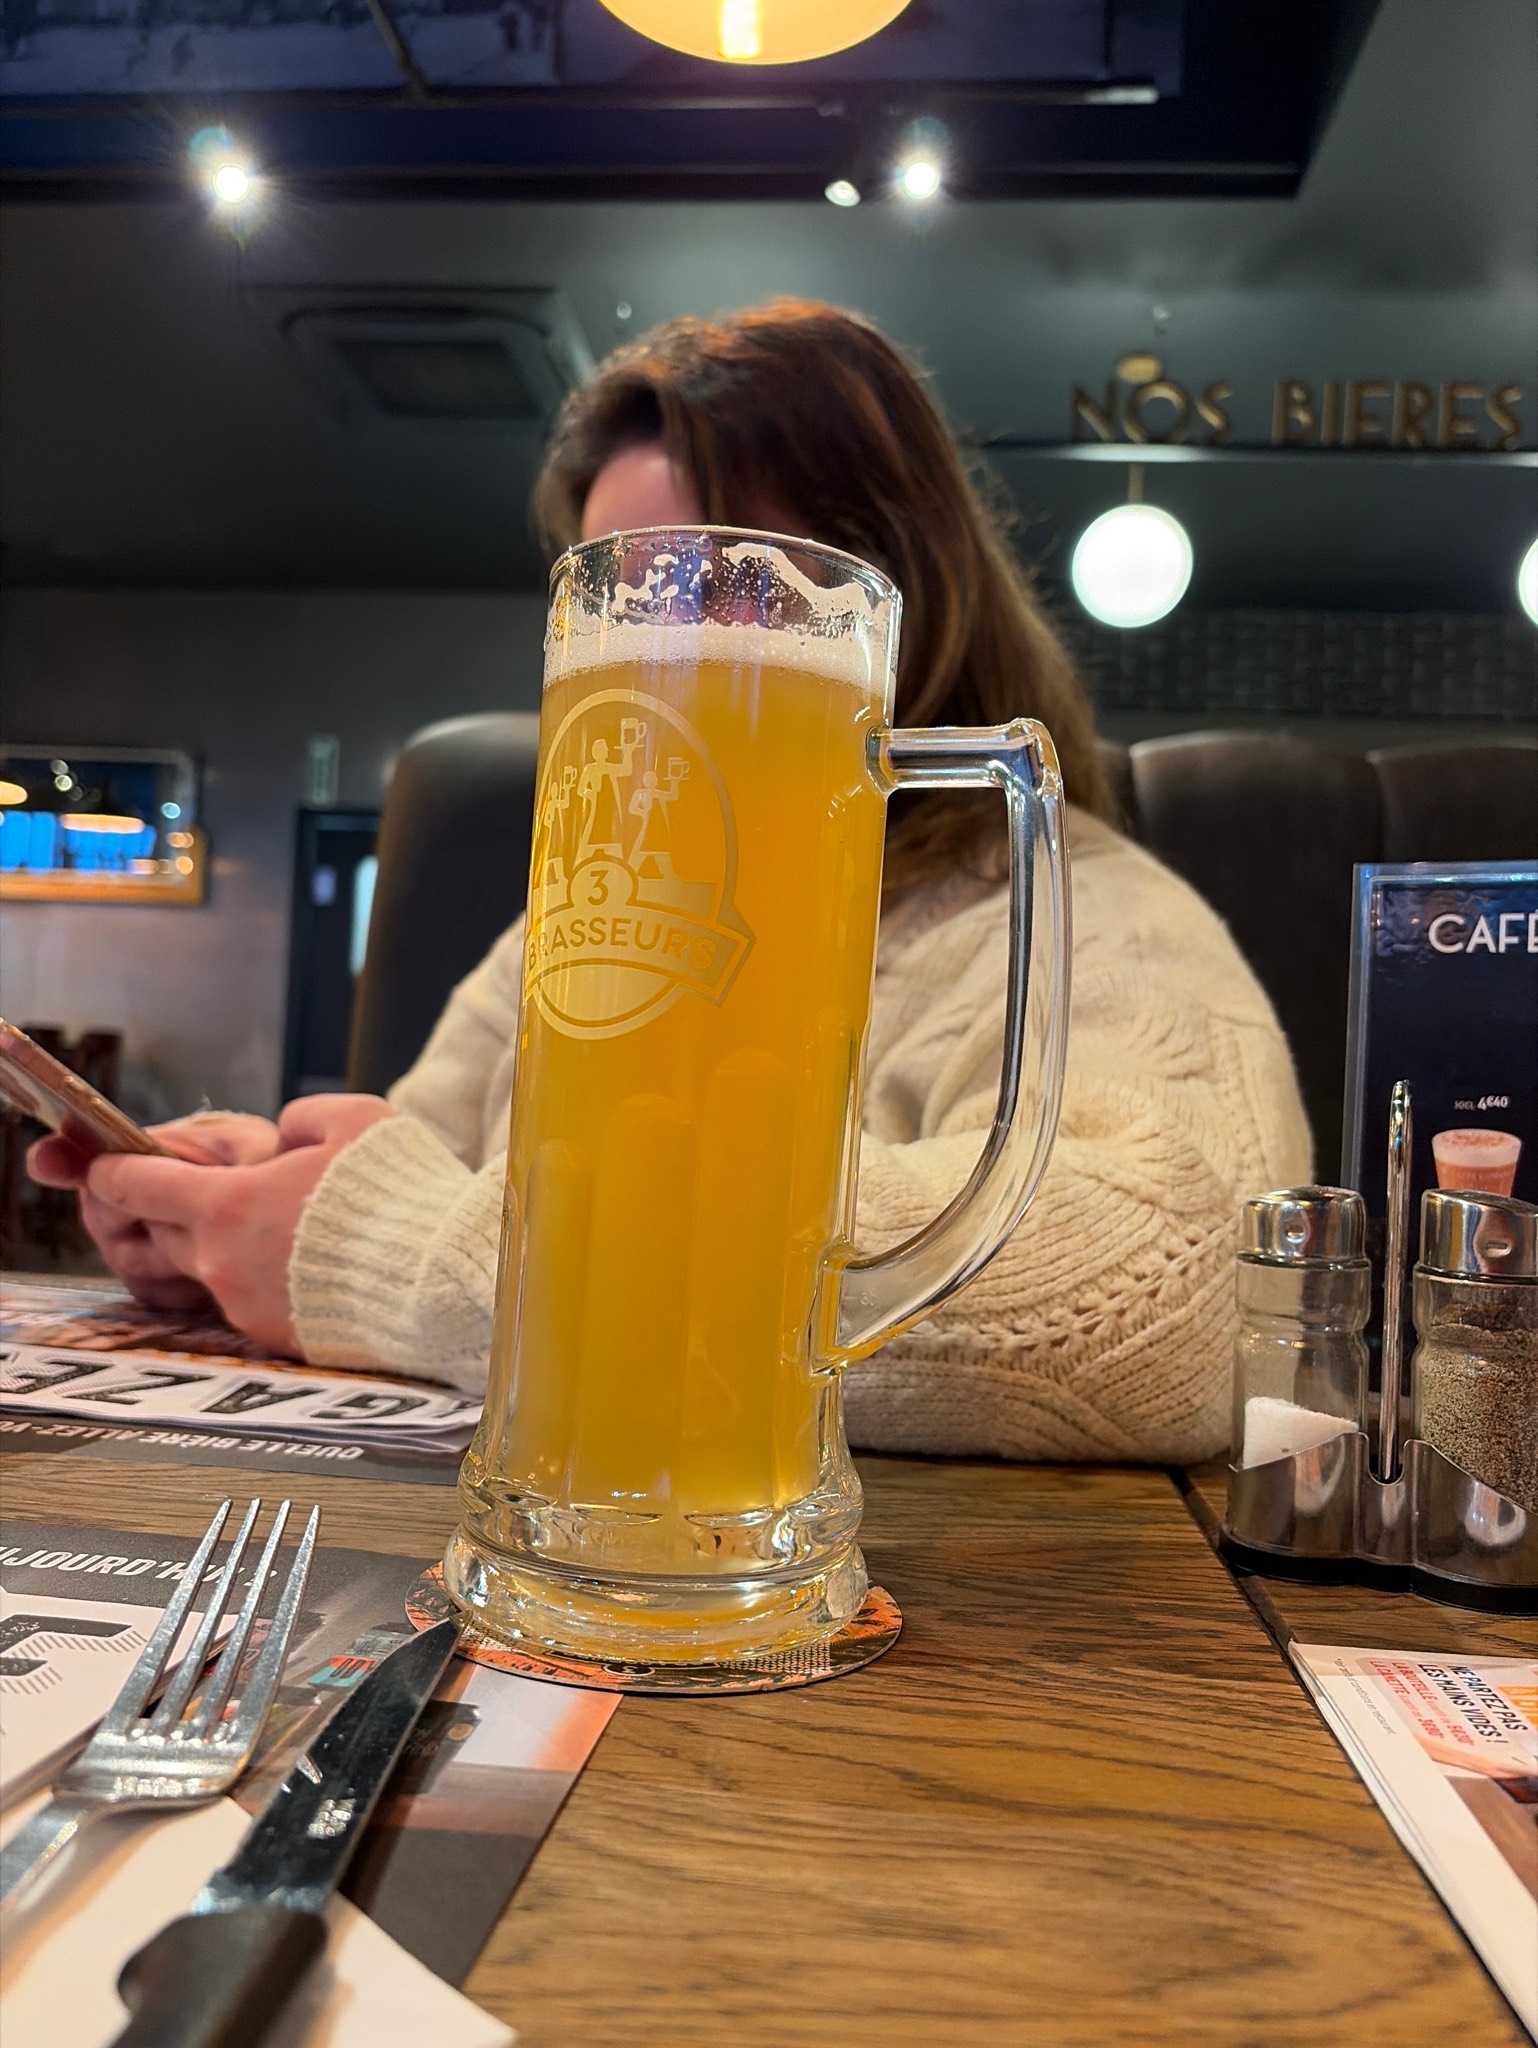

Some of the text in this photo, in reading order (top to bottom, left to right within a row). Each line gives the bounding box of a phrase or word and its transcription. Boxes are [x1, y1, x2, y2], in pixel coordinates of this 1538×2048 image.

[1070, 379, 1233, 445] NOS
[586, 869, 609, 906] 3
[528, 918, 716, 972] BRASSEURS
[0, 1353, 430, 1419] GAZE
[138, 1431, 242, 1449] BIÈRE
[238, 1439, 364, 1460] QUELLE
[1417, 1664, 1449, 1678] LES
[1447, 1665, 1476, 1676] NE
[1432, 1679, 1475, 1706] MAINS
[1459, 1676, 1509, 1710] PARTEZ
[1460, 1708, 1502, 1737] VIDES
[1492, 1711, 1528, 1730] PAS
